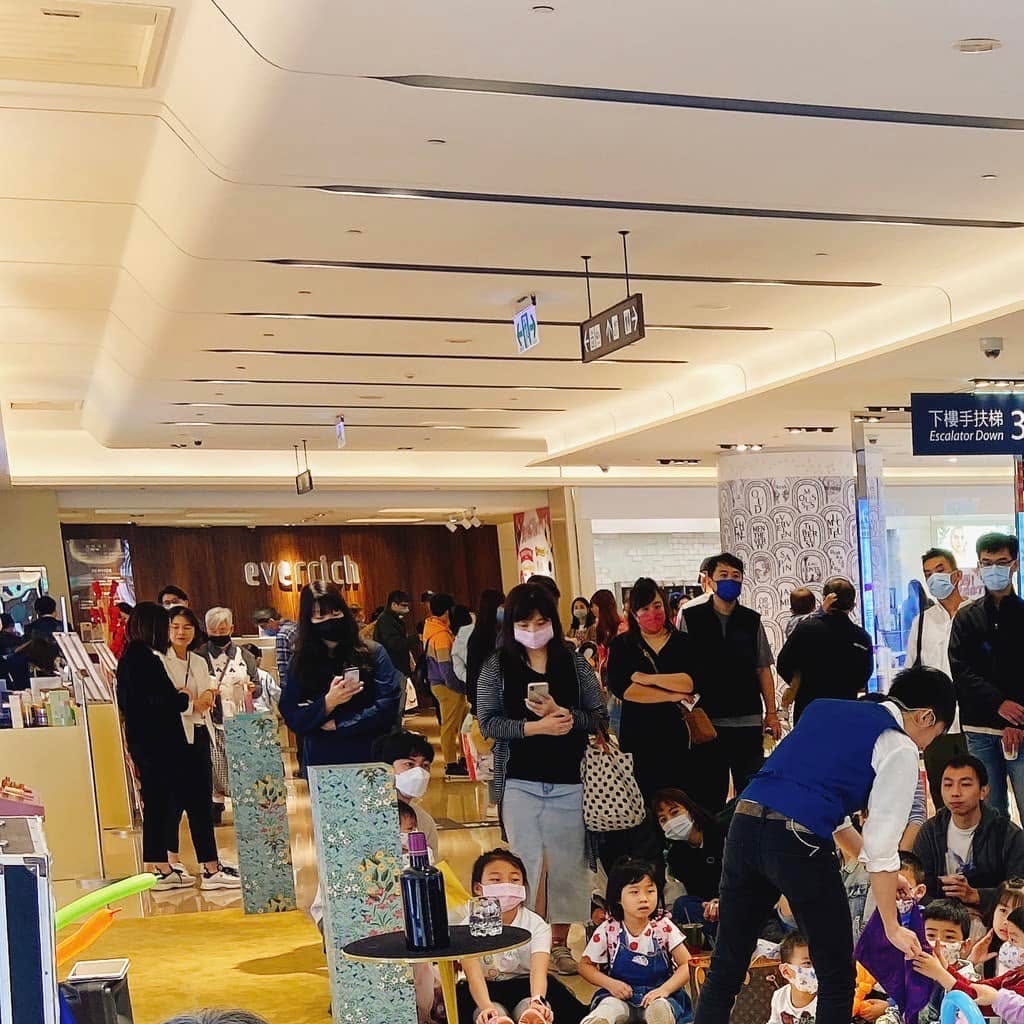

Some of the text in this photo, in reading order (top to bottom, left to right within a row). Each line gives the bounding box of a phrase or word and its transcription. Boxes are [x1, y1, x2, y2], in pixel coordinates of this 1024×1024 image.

[928, 410, 1004, 428] 下樓手扶梯
[929, 430, 1004, 442] Escalator Down
[244, 555, 360, 586] everrich
